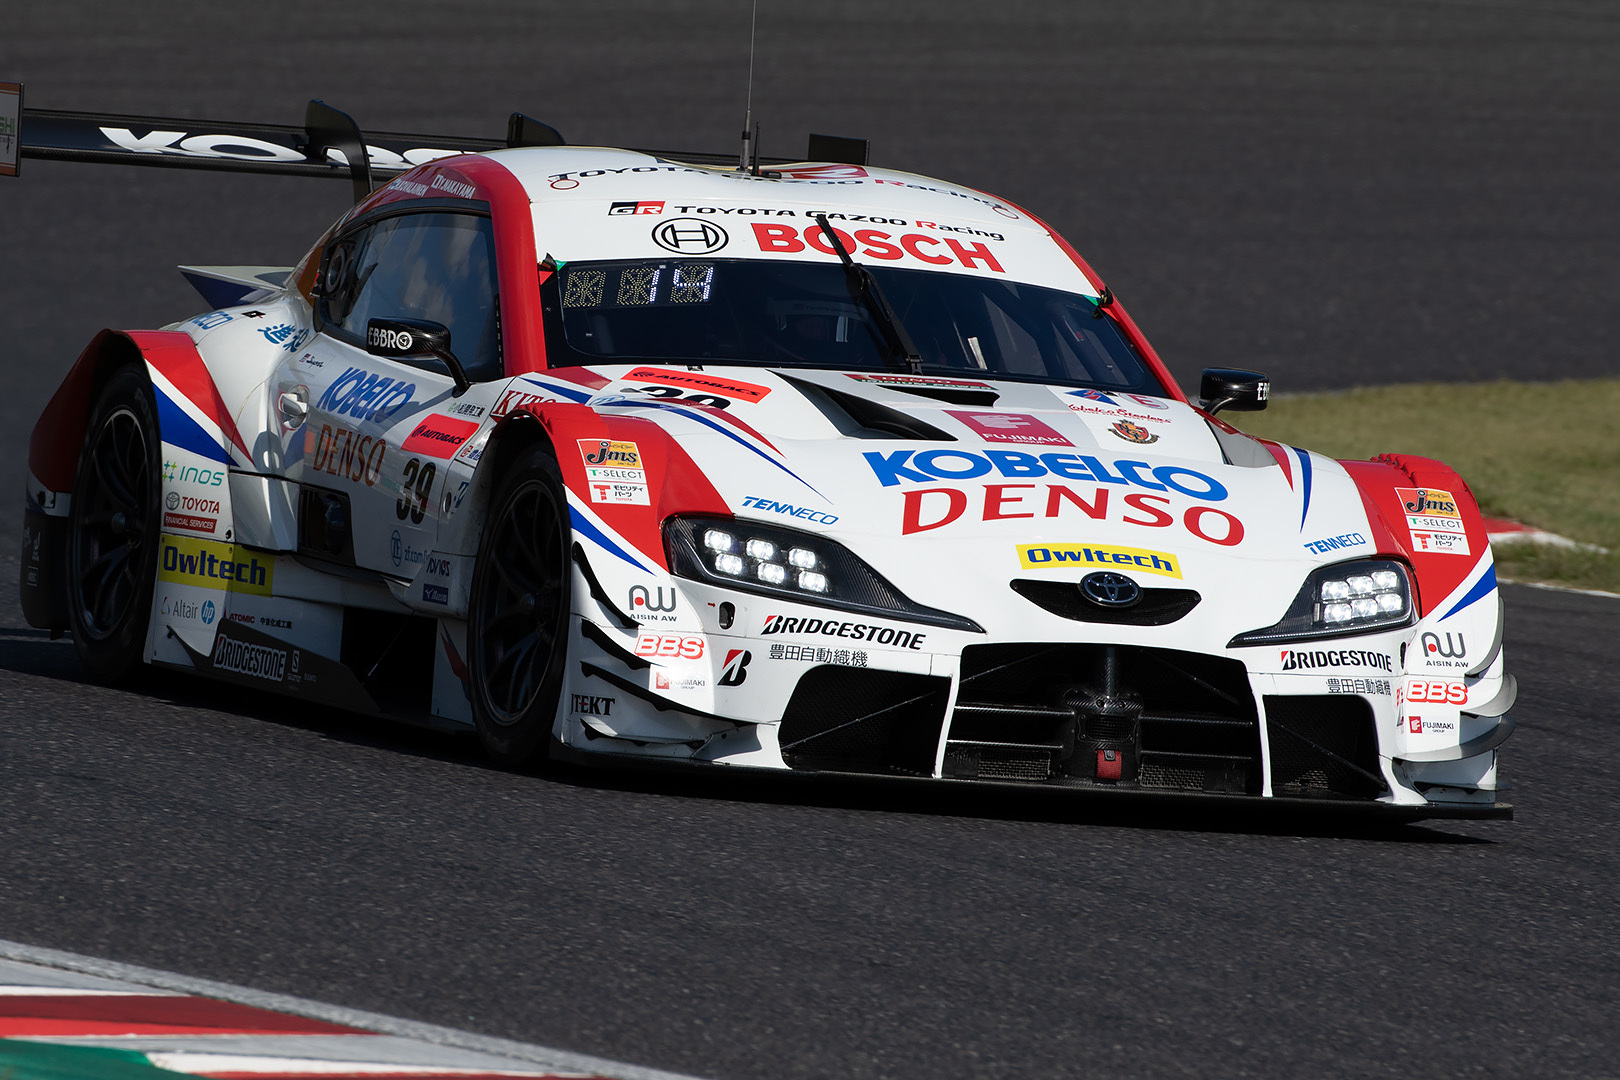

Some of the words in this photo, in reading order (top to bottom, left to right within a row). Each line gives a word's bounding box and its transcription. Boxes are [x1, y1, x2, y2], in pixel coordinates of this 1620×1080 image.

[674, 205, 796, 217] TOYOTA
[805, 210, 908, 226] GAZOO
[915, 220, 1006, 241] Racing
[750, 222, 1007, 273] BOSCH
[368, 326, 413, 350] EBBRO
[654, 373, 762, 397] AUTOBACS
[882, 376, 951, 384] DENSO
[316, 366, 416, 424] KOBELCO
[421, 428, 465, 445] AUTOBACS
[981, 433, 1067, 443] FUJIMAKI
[313, 424, 387, 487] DENSO
[586, 441, 637, 464] jms
[589, 469, 642, 479] T-SELECT
[861, 449, 1229, 502] KOBELCO
[396, 457, 437, 525] 39
[1405, 489, 1455, 513] jms
[181, 496, 220, 514] TOYOTA
[742, 496, 839, 525] TENNECO
[901, 483, 1246, 547] DENSO
[165, 516, 189, 526] FINANCIAL
[189, 519, 214, 529] SERVICES
[1409, 517, 1461, 529] T-SELECT
[1303, 532, 1367, 555] TENNECO
[163, 546, 267, 585] Owltech
[1026, 548, 1173, 572] Owltech
[173, 599, 198, 619] Altair
[202, 600, 215, 624] hp
[229, 613, 255, 624] ATOMIC
[630, 613, 658, 621] AISIN
[760, 615, 926, 650] BRIDGESTONE
[214, 633, 287, 681] BRIDGESTONE
[634, 634, 705, 660] BBS
[769, 643, 868, 668] 豊田自動織機
[1281, 650, 1392, 673] BRIDGESTONE
[1327, 678, 1391, 696] 豊田自動織機
[1406, 680, 1469, 705] BBS
[1422, 721, 1454, 730] FUJIMAKI
